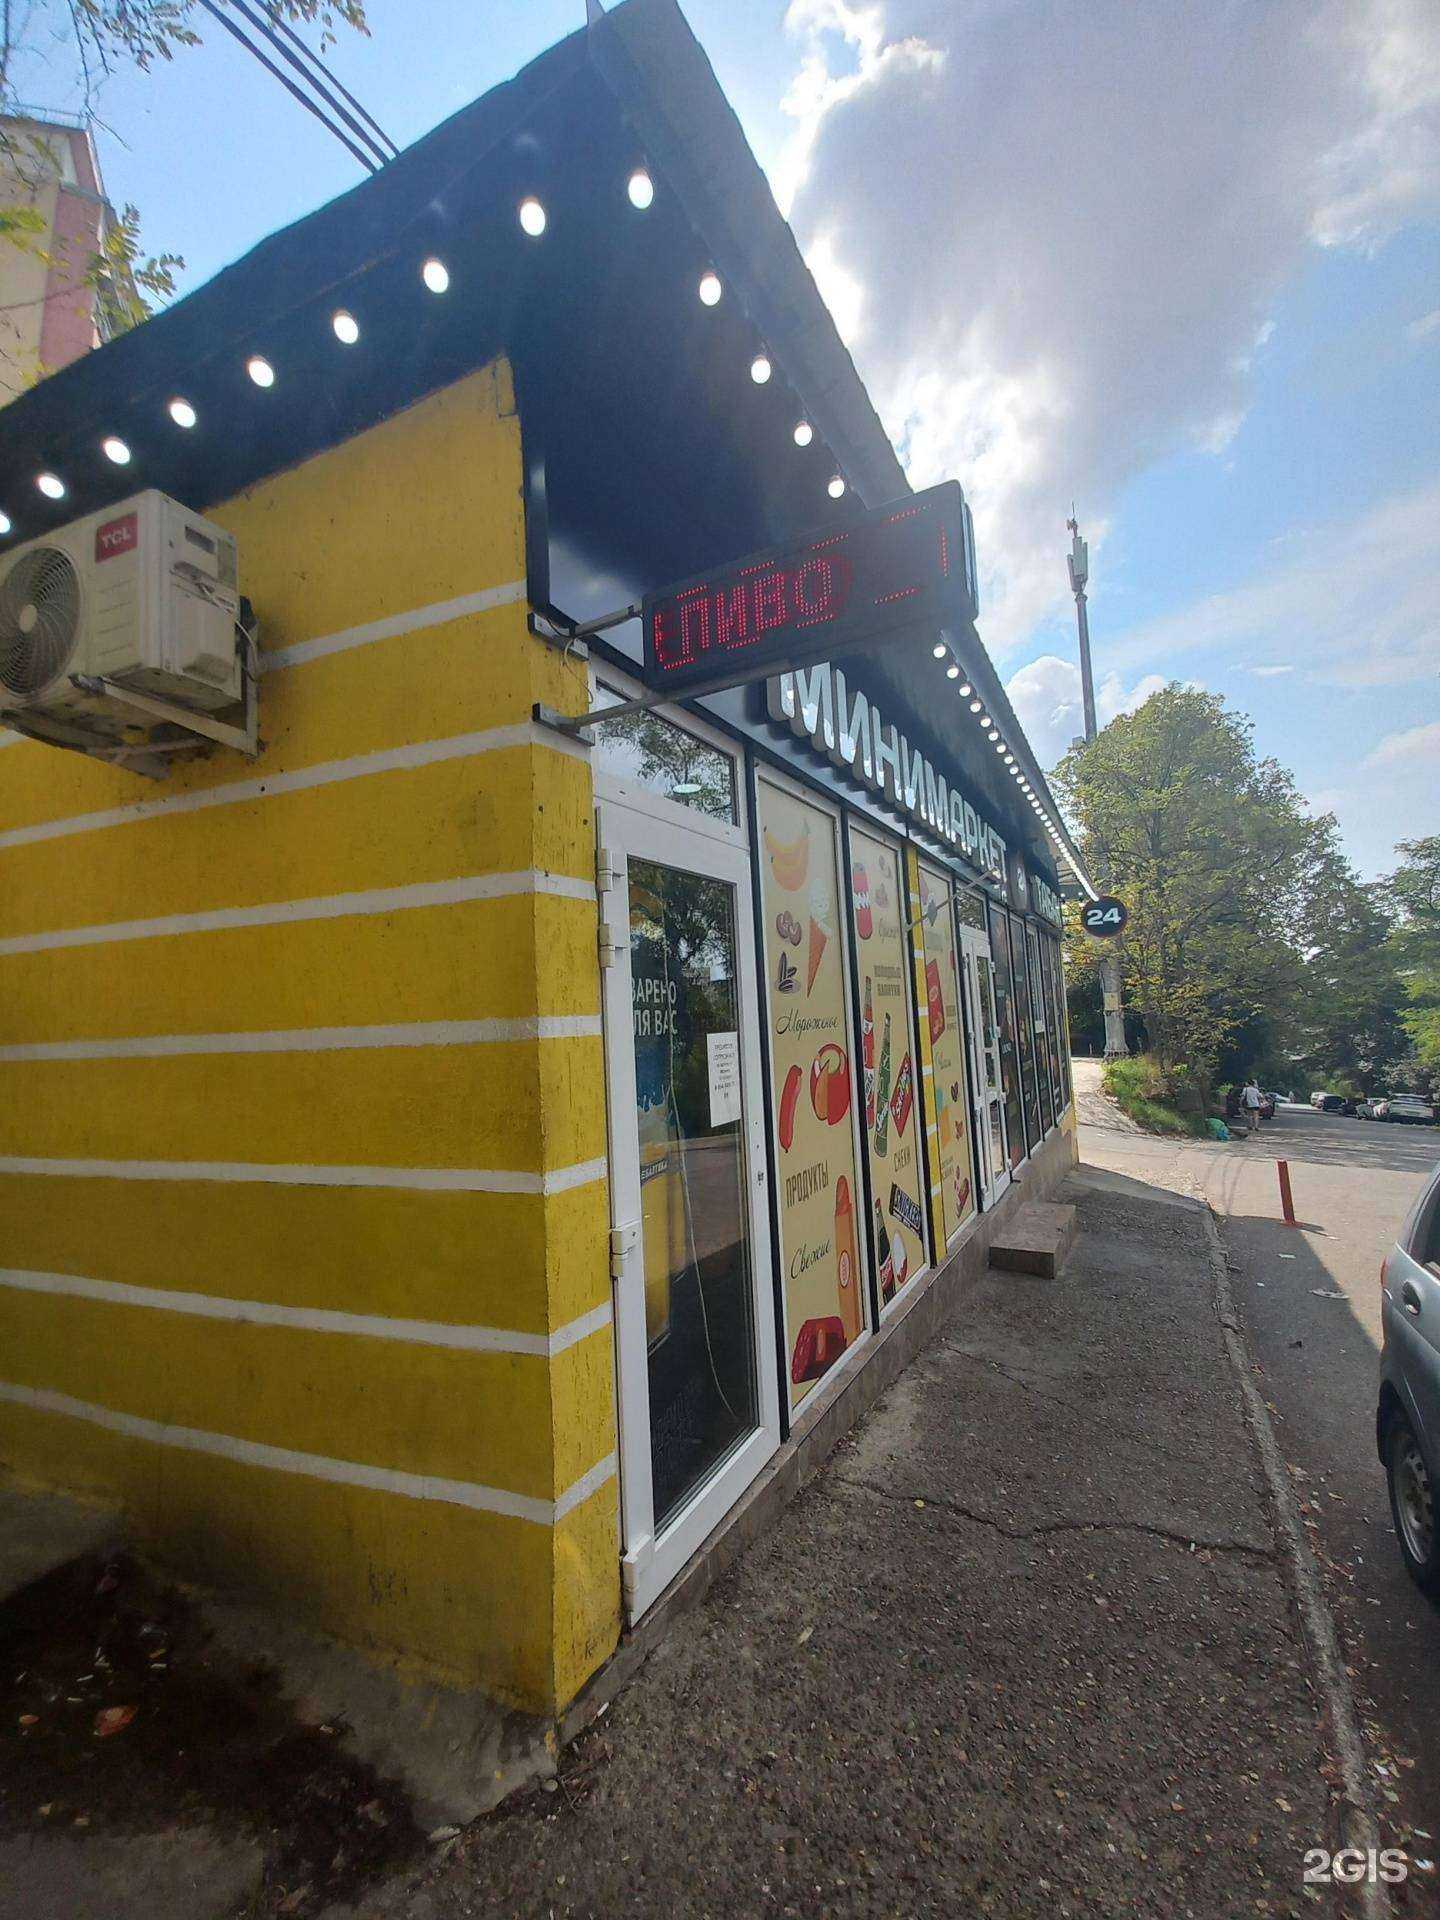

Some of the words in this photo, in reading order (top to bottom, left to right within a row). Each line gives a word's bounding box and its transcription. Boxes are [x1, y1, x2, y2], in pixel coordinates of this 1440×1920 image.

[102, 527, 131, 549] TCL
[680, 557, 834, 656] ПИВО
[780, 661, 1007, 883] МИНИМАРКЕТ
[1087, 907, 1121, 926] 24
[654, 1009, 678, 1035] ВАС
[785, 1160, 829, 1208] ПРОДУКТЫ
